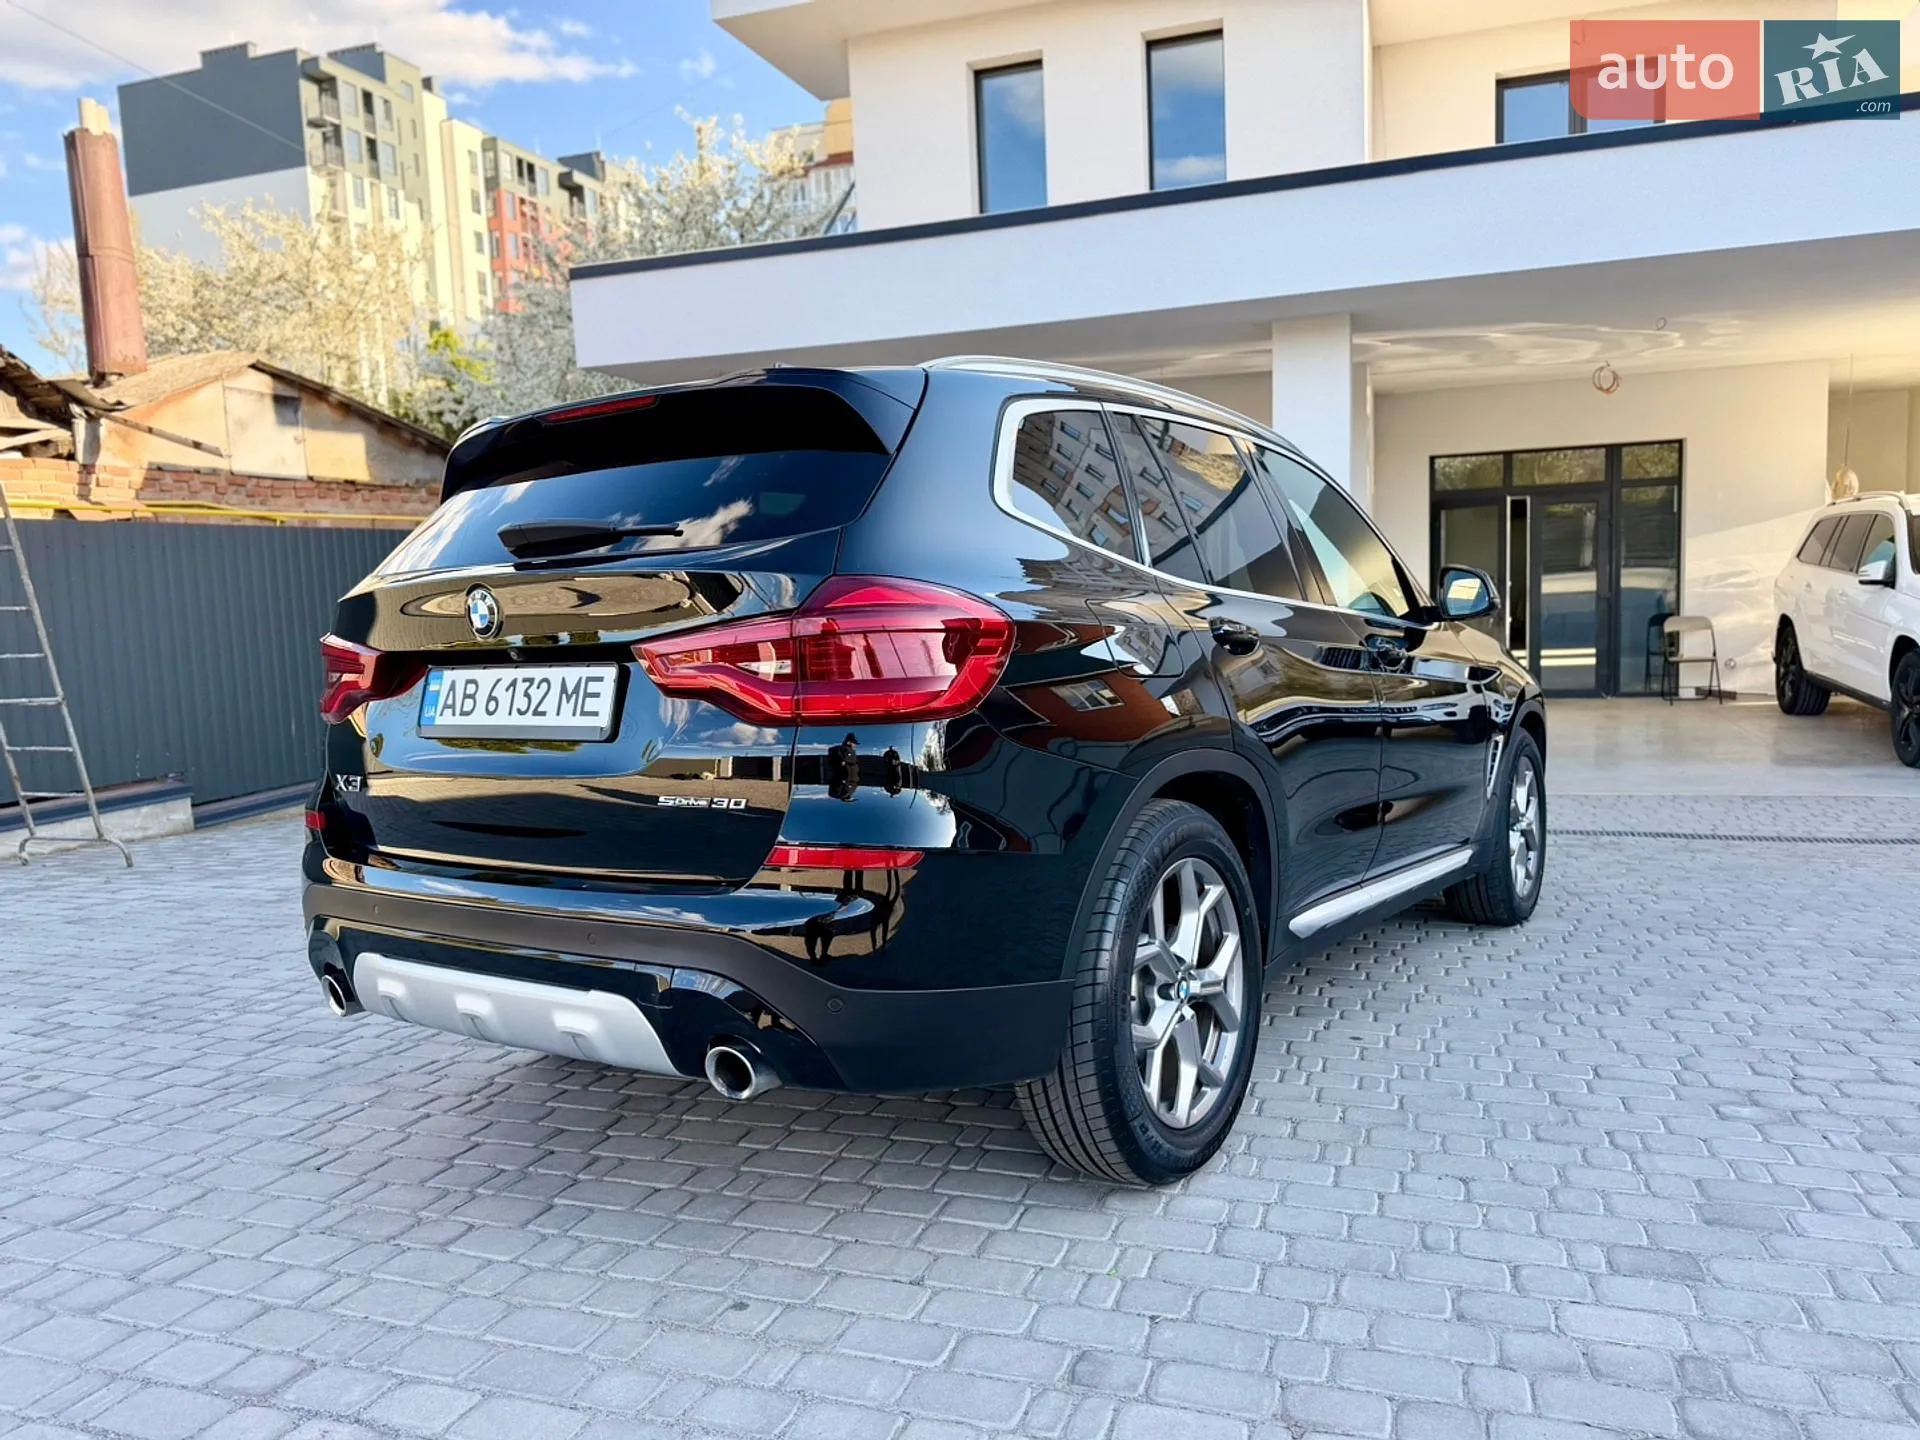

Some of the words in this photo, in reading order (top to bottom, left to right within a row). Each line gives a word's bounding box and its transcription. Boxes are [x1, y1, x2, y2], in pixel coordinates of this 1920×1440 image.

[439, 678, 480, 717] AB
[485, 676, 552, 717] 6132
[556, 674, 605, 717] ME
[336, 774, 362, 792] X3
